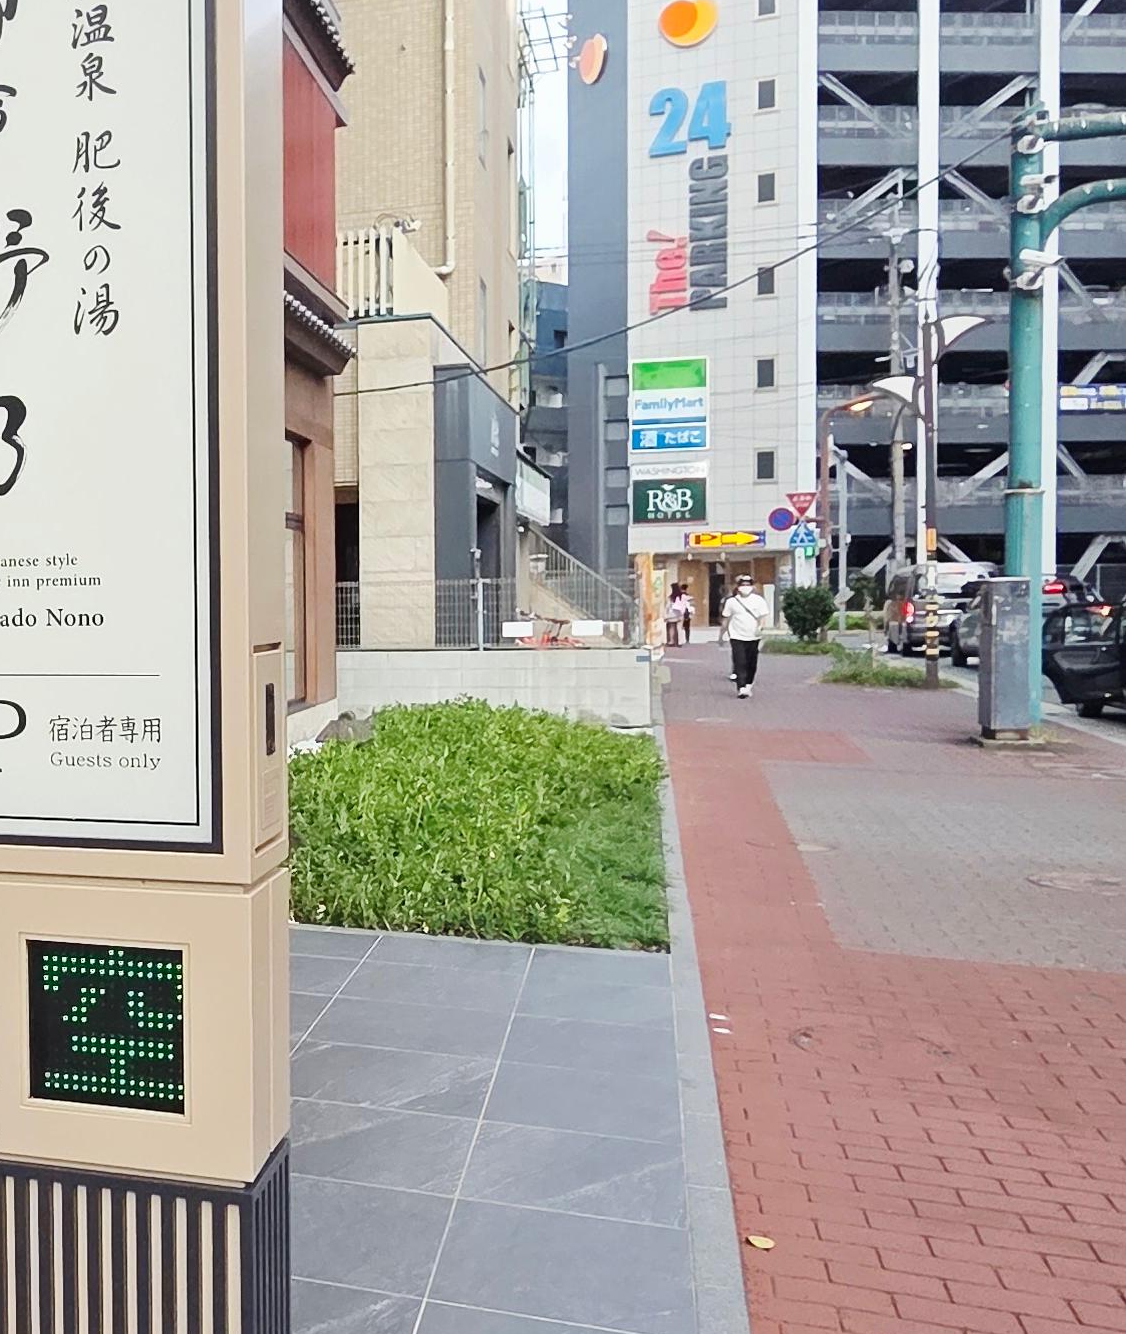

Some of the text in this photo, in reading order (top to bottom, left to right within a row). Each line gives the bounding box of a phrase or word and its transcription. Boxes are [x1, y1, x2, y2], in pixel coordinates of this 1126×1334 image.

[649, 80, 732, 158] 24
[72, 130, 122, 336] 肥後の湯
[688, 154, 729, 311] PARKING
[635, 397, 704, 412] FamilyMart
[664, 429, 702, 445] たばこ
[647, 487, 693, 512] R&B
[46, 553, 78, 569] style
[7, 576, 30, 588] inn
[36, 574, 101, 590] premium
[45, 608, 104, 627] Nono
[49, 714, 161, 744] 宿泊者専用
[50, 751, 161, 770] Guests only
